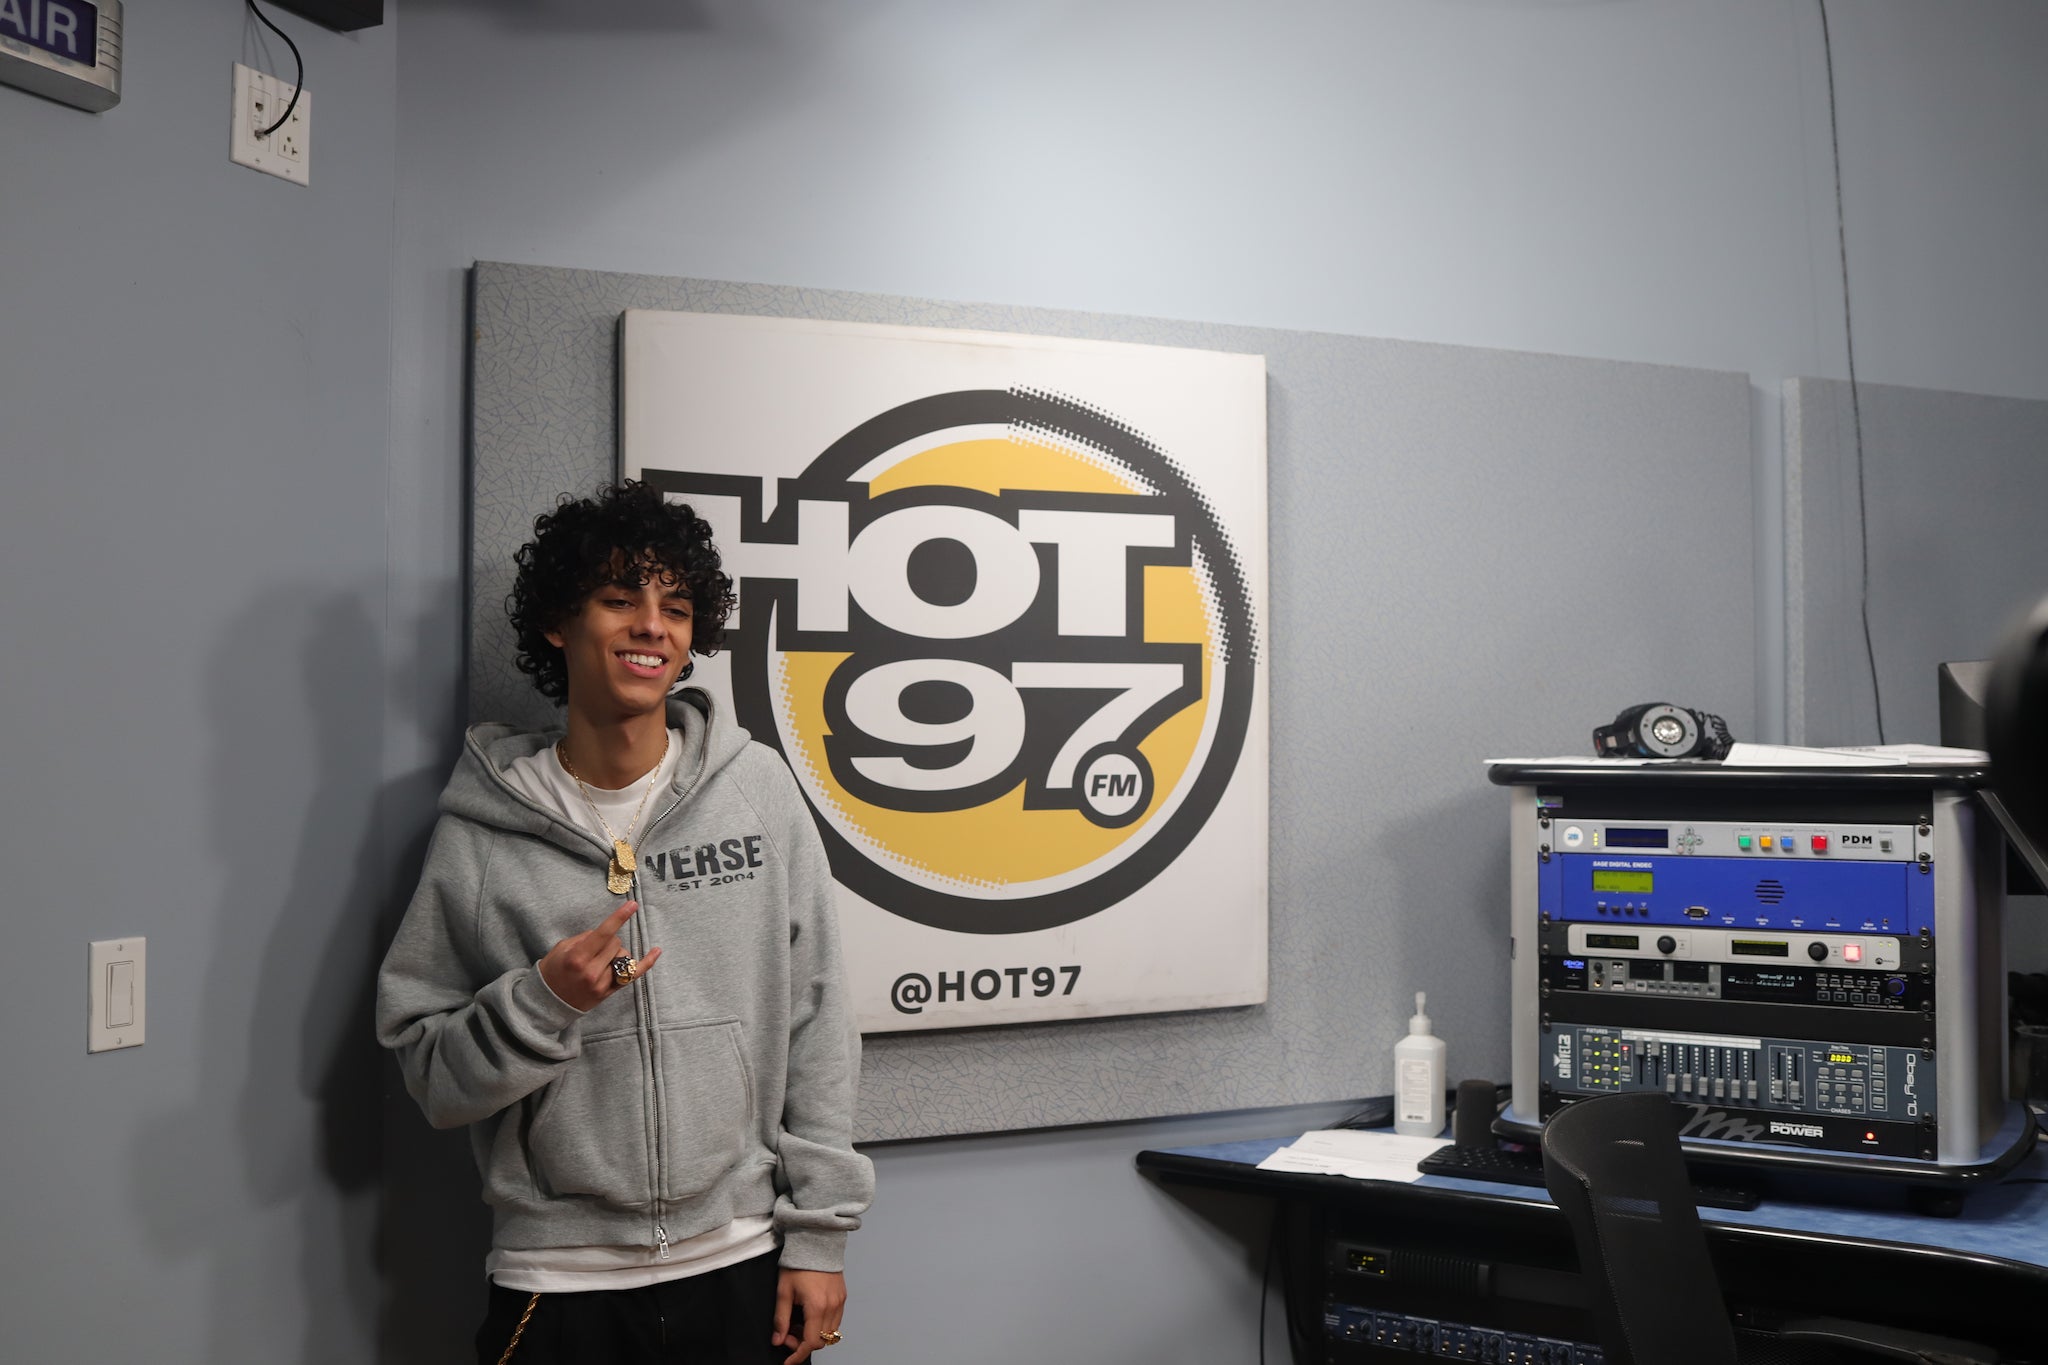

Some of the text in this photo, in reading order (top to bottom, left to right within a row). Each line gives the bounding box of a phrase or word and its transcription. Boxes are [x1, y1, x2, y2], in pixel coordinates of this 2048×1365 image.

[662, 491, 1176, 640] HOT
[845, 658, 1185, 792] 97
[1090, 773, 1138, 798] FM
[1842, 835, 1873, 845] PDM
[645, 835, 764, 883] VERSE
[1609, 861, 1632, 869] DIGITAL
[667, 871, 756, 893] EST 2004
[890, 965, 1082, 1015] @HOT97
[1830, 1107, 1852, 1115] CHASES
[1770, 1125, 1824, 1138] POWER
